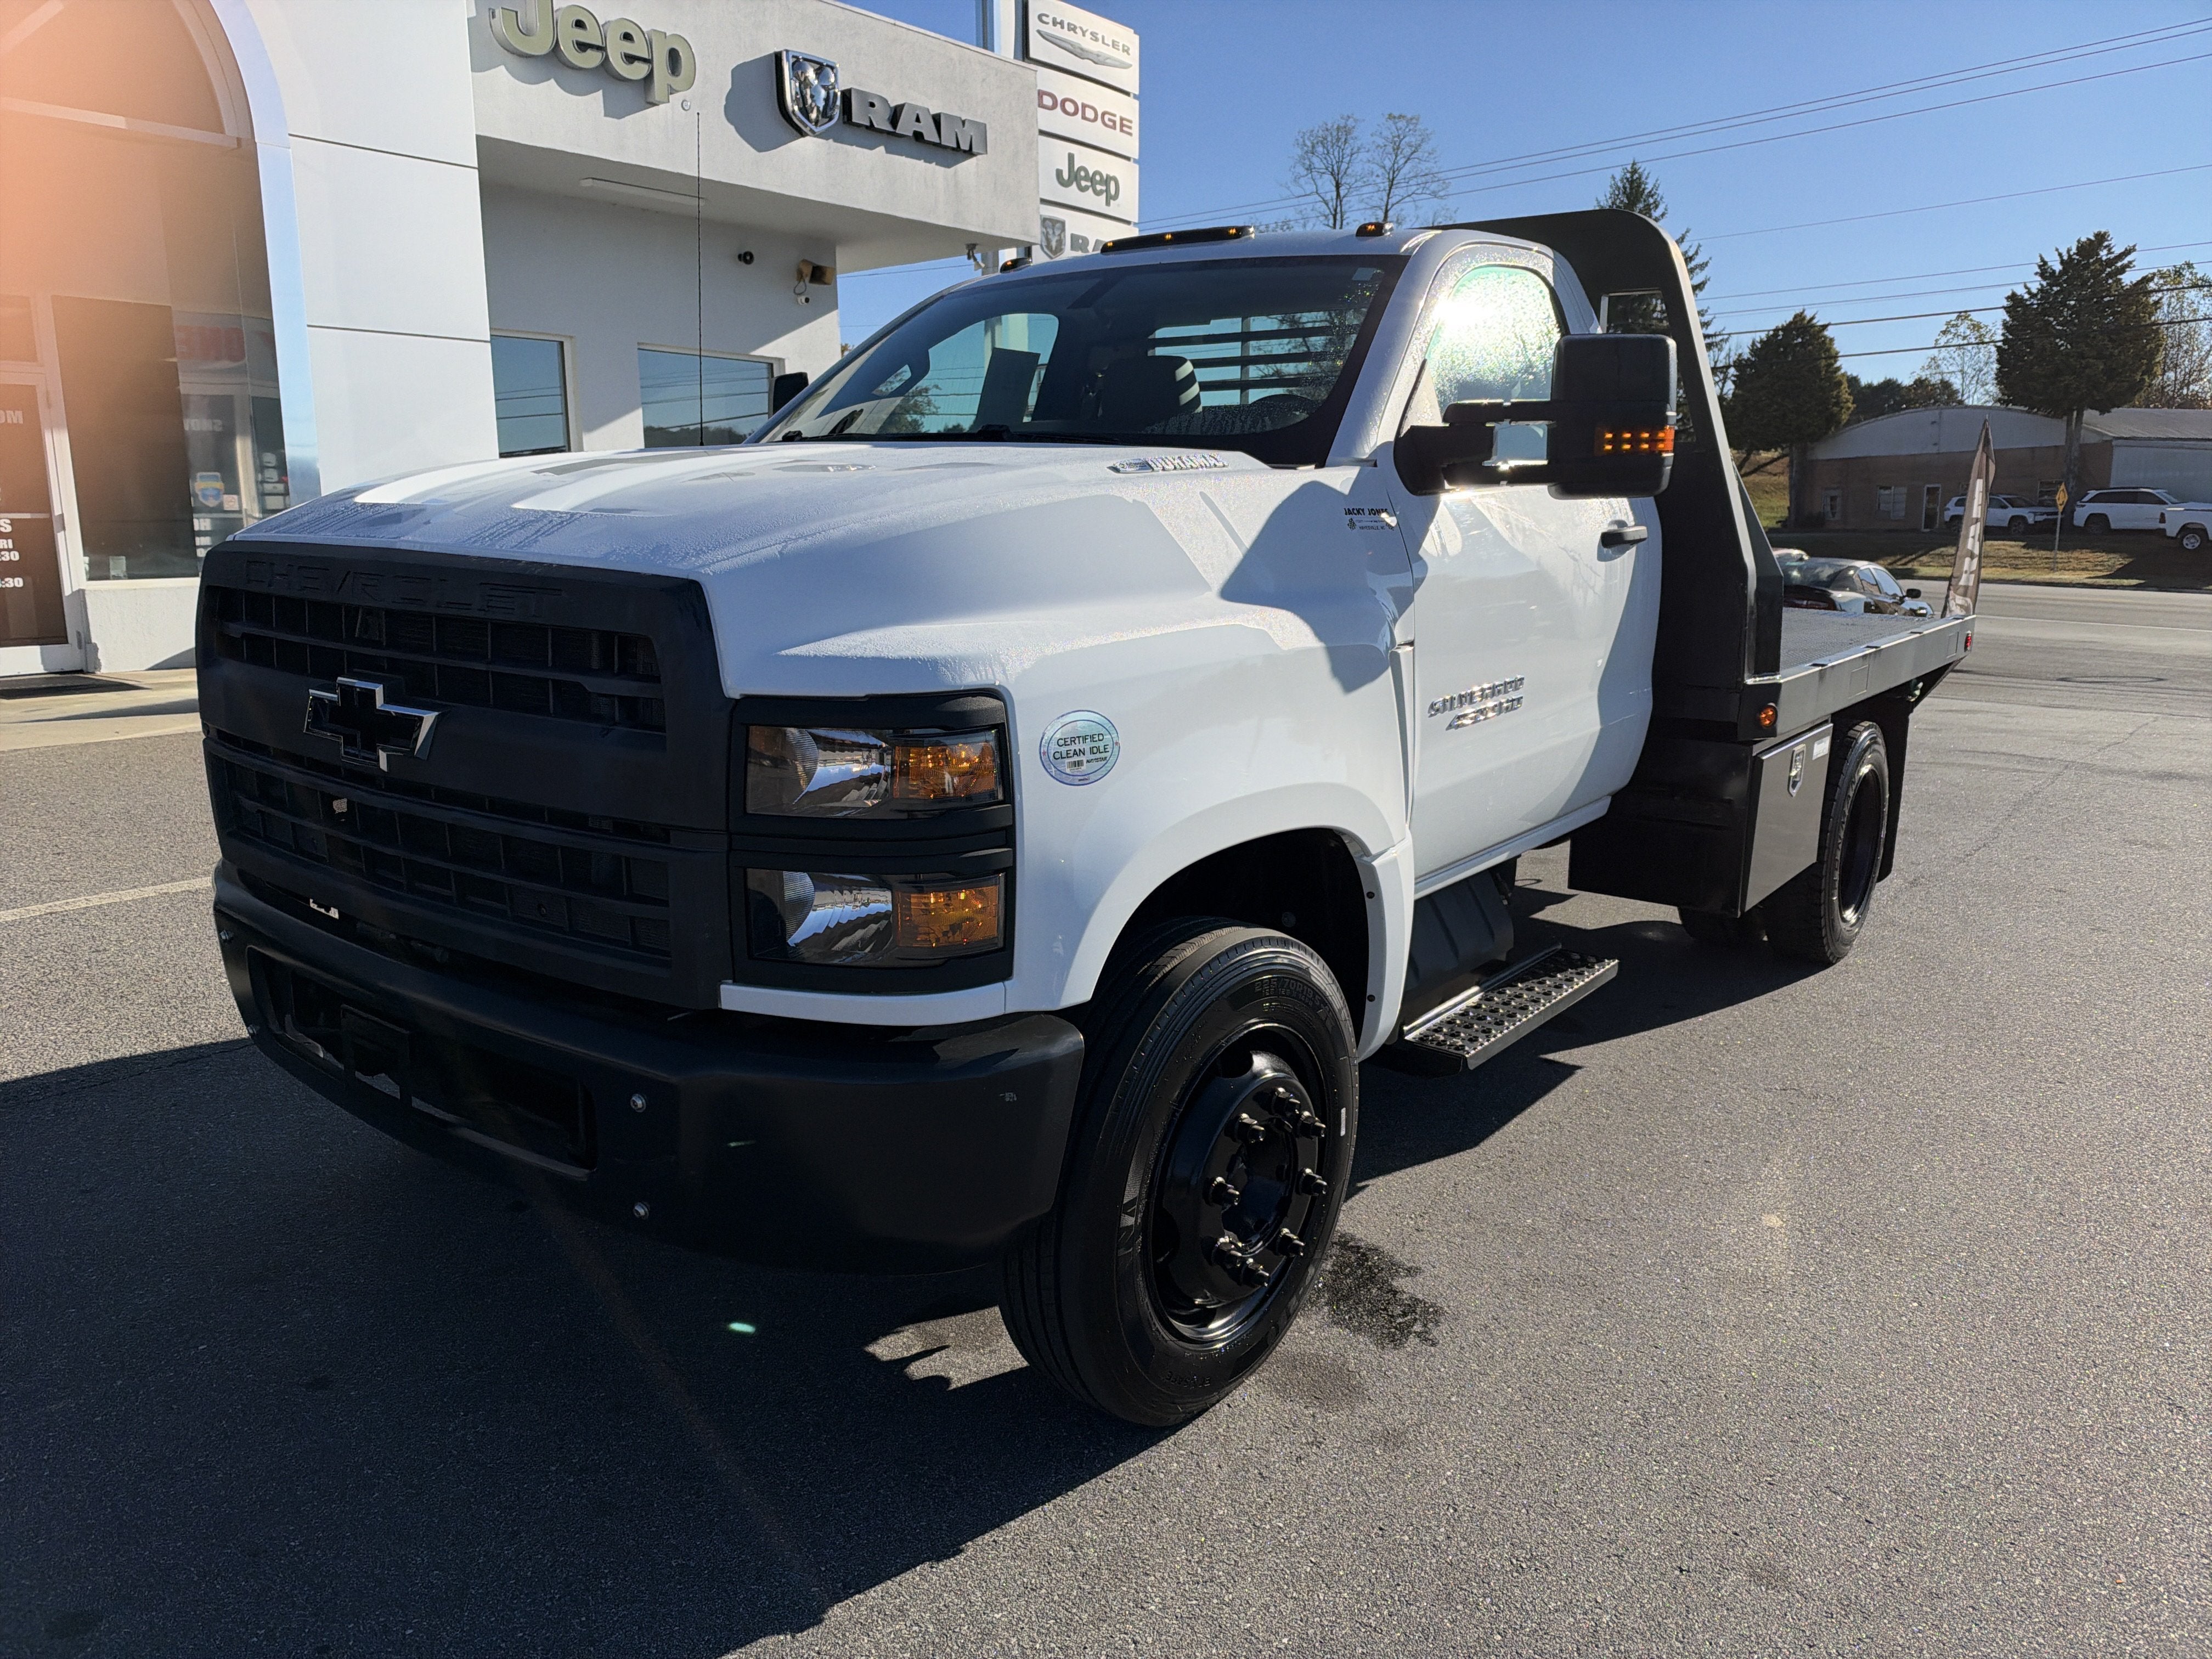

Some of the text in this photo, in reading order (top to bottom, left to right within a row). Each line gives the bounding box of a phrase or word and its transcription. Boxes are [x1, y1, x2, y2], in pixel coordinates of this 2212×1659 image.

[489, 0, 696, 104] Jeep
[1037, 13, 1131, 55] CHRYSLER
[848, 87, 988, 155] RAM
[1037, 89, 1133, 137] DODGE
[1056, 152, 1120, 207] Jeep
[1053, 744, 1110, 760] CLEAN IDLE
[1057, 733, 1104, 747] CERTIFIED
